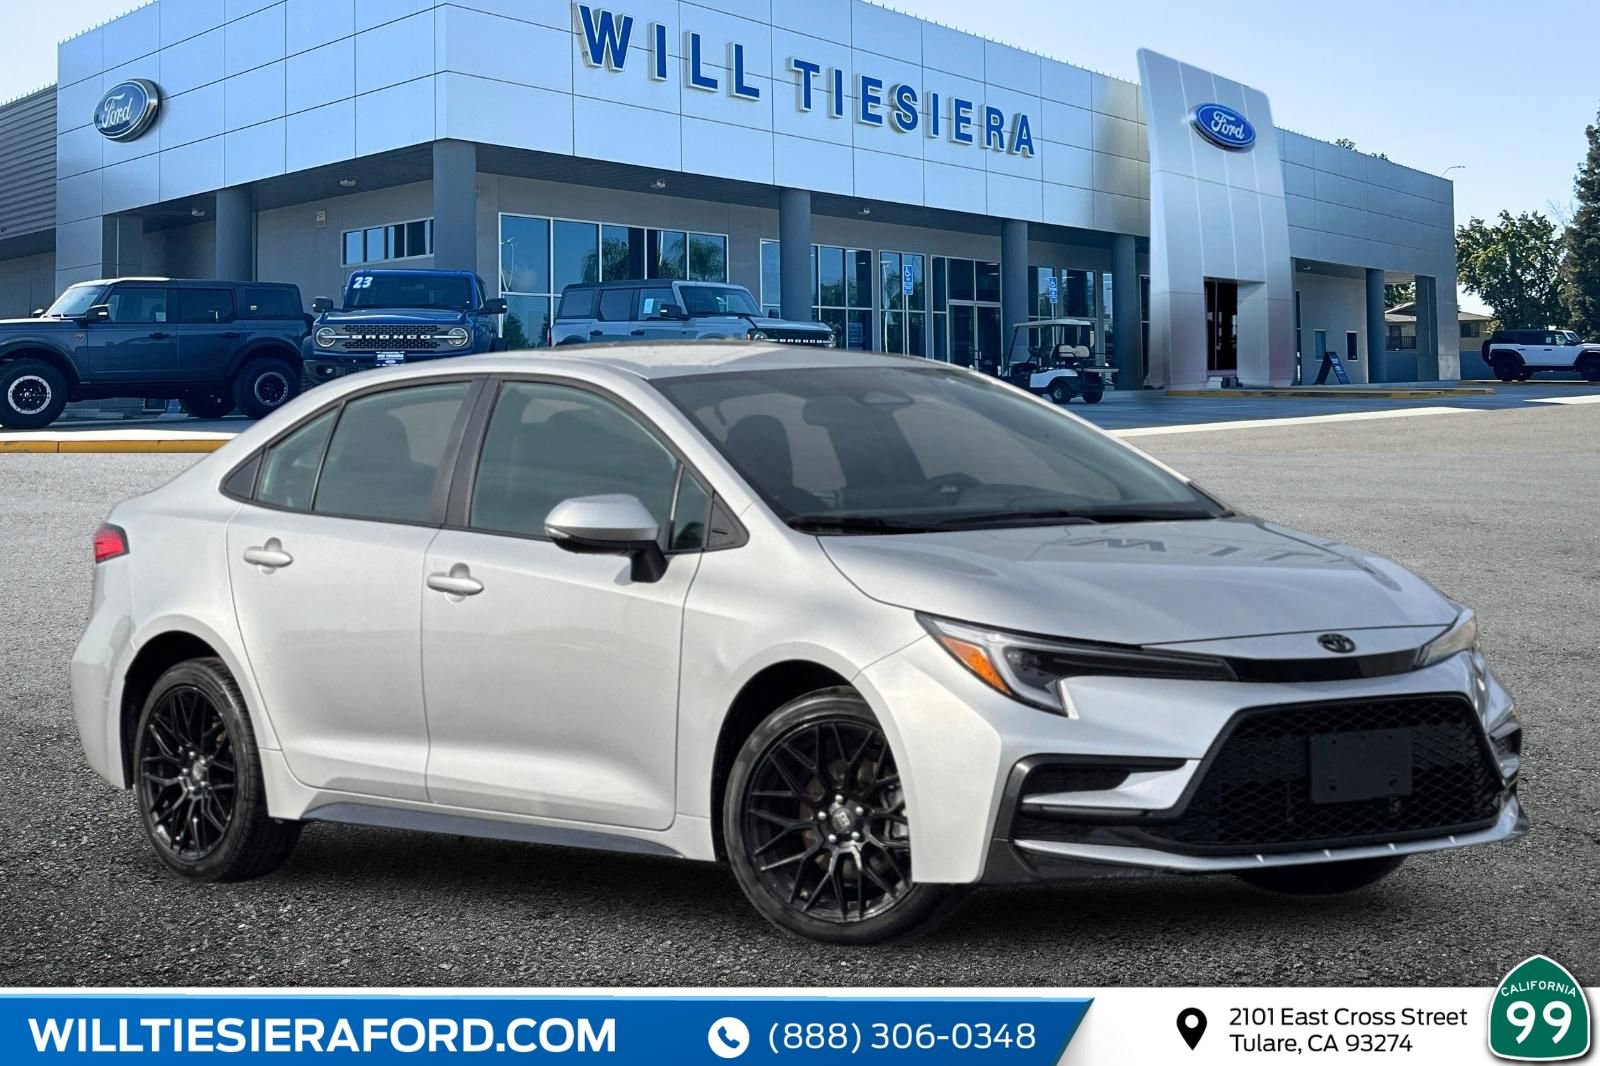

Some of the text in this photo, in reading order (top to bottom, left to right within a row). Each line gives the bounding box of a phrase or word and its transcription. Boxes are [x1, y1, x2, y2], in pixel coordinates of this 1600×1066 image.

[575, 3, 1035, 157] WILL TIESIERA
[102, 93, 133, 128] Ford
[1211, 110, 1245, 139] Ford
[352, 276, 373, 289] 23
